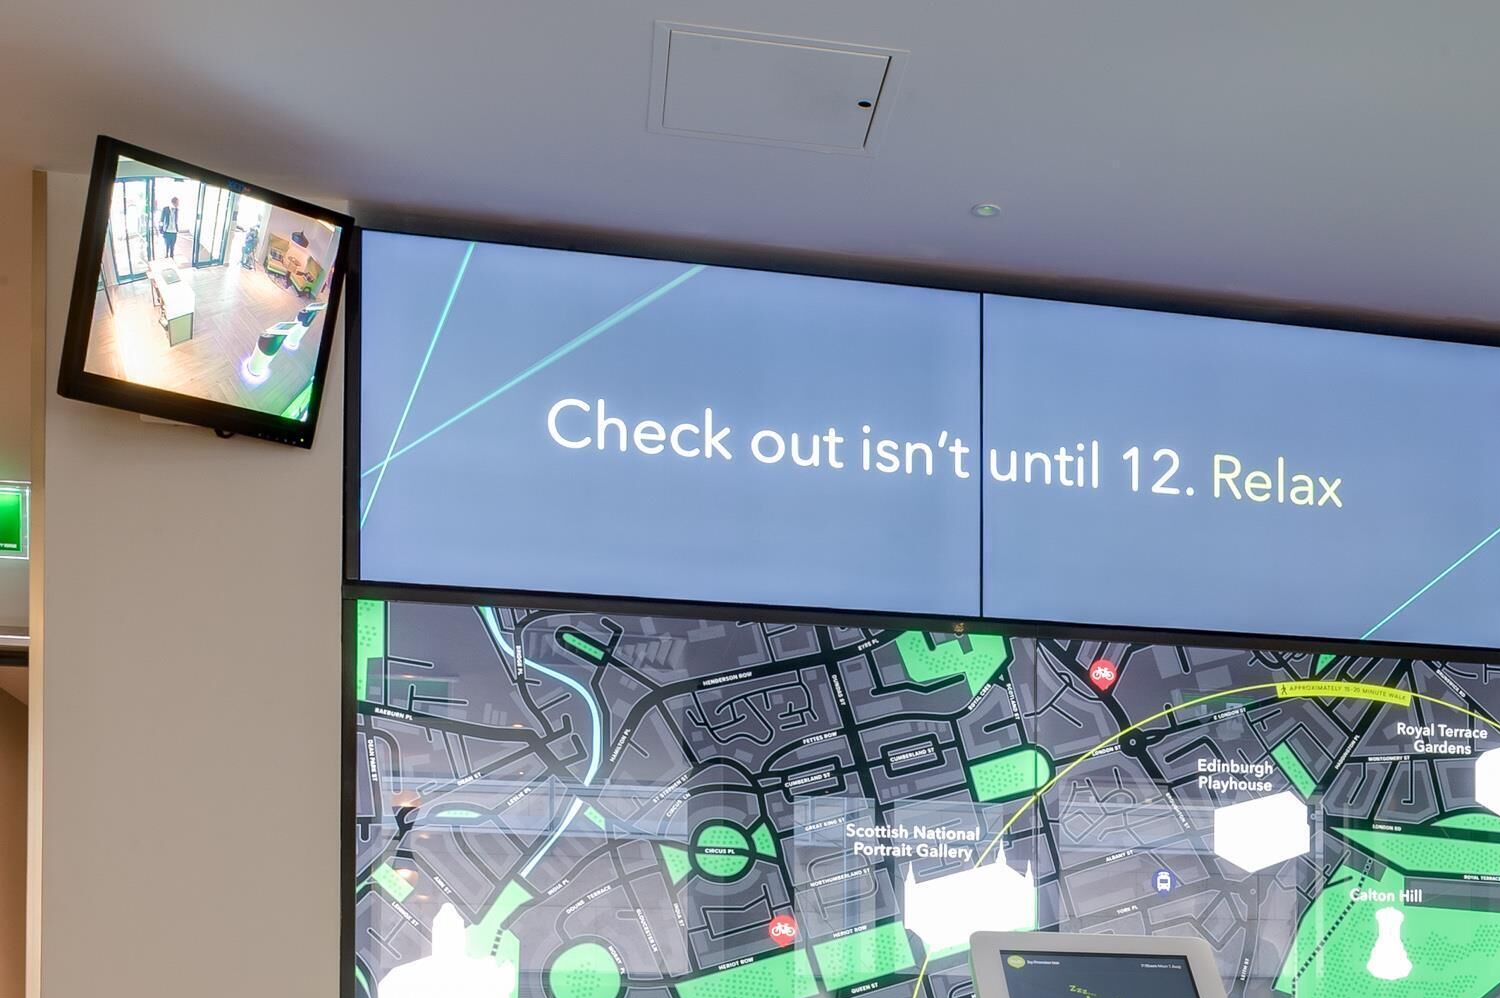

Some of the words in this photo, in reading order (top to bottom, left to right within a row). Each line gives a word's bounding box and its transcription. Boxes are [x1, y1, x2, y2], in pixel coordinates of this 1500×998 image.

[546, 398, 732, 460] Check
[750, 426, 844, 470] out
[861, 425, 970, 478] isn't
[989, 441, 1100, 489] until
[1122, 446, 1195, 496] 12.
[1213, 454, 1342, 508] Relax
[702, 674, 736, 686] HENDERSON
[1396, 722, 1435, 740] Royal
[1438, 724, 1488, 739] Terrace
[1414, 740, 1472, 755] Gardens
[1198, 759, 1273, 776] Edinburgh
[784, 774, 822, 788] CUMBERLAND
[1199, 776, 1272, 792] Playhouse
[846, 823, 909, 840] Scottish
[914, 825, 980, 841] National
[854, 842, 912, 858] Portrait
[917, 843, 973, 861] Gallery
[1350, 888, 1394, 902] Calton
[1400, 889, 1422, 902] Hill
[851, 984, 868, 994] QUEEN
[869, 982, 878, 990] ST
